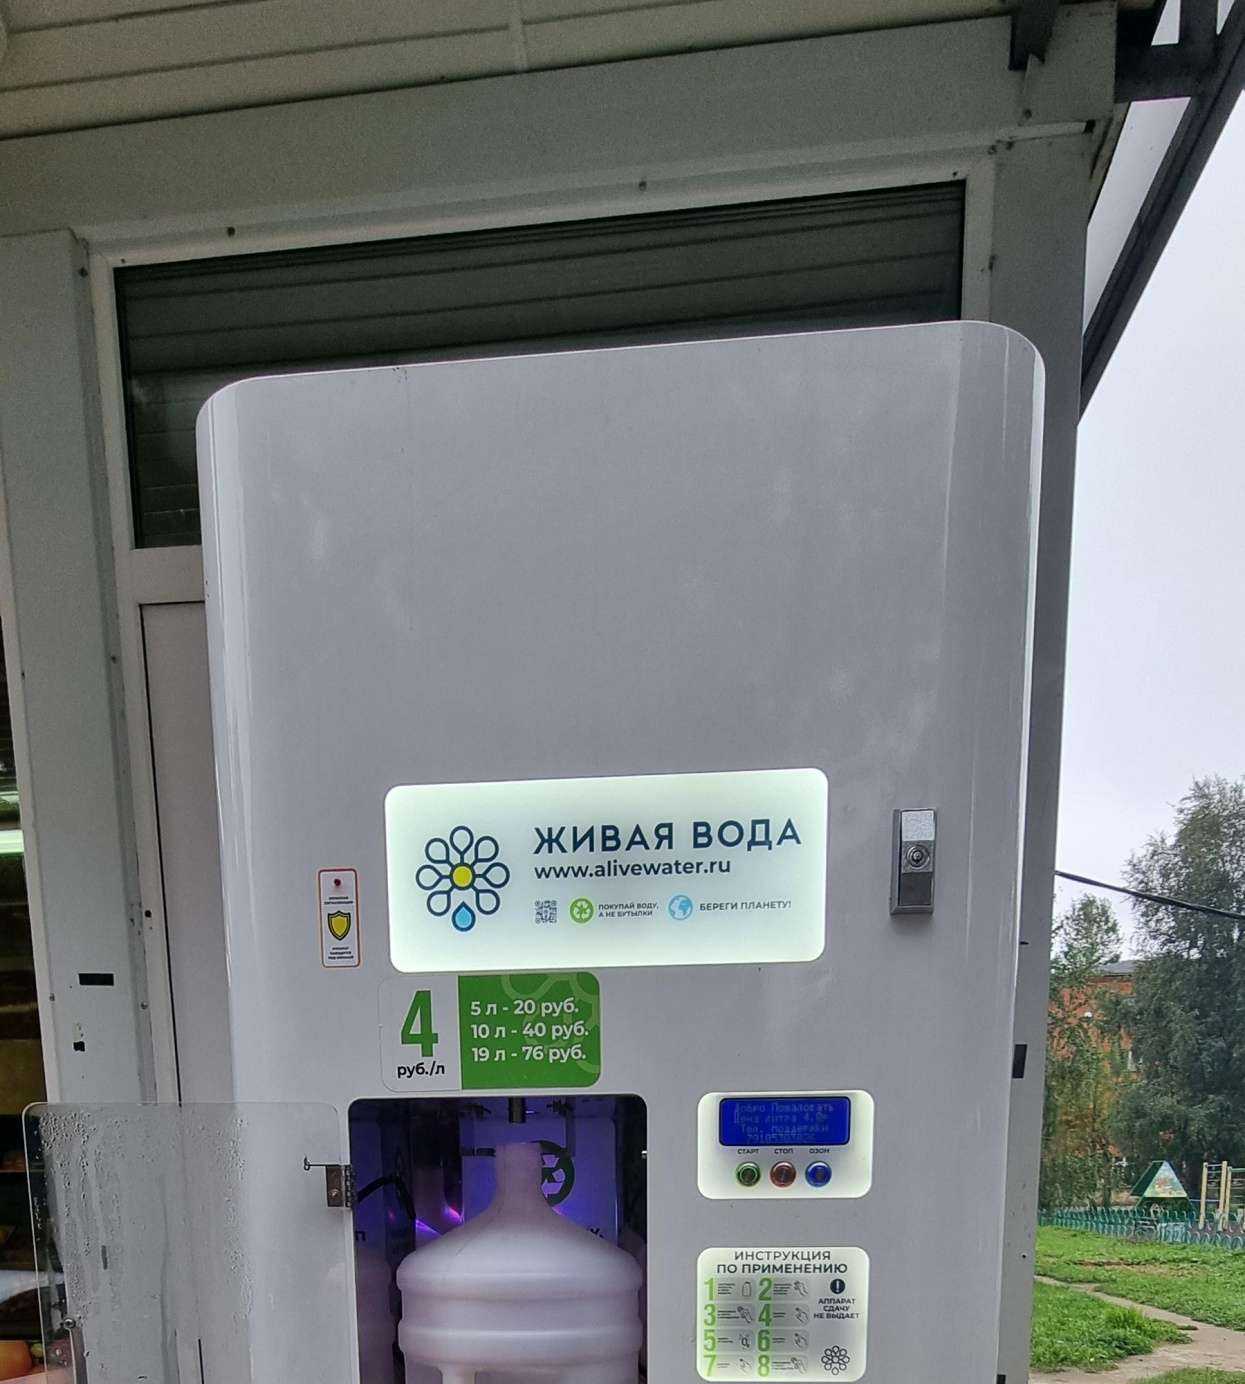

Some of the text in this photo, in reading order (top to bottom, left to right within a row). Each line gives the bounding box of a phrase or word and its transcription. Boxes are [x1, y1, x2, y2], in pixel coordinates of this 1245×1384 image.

[533, 818, 802, 854] ЖИВАЯ ВОДА
[534, 859, 731, 879] www.alivewater.ru
[599, 902, 635, 911] ПОКУПАЙ
[617, 910, 653, 918] БУТЫЛКИ
[700, 901, 791, 911] БЕРЕГИ ПЛАНЕТУ!
[470, 1001, 481, 1016] 5
[485, 1003, 497, 1015] л
[514, 1000, 535, 1015] 20
[541, 997, 579, 1017] руб.
[401, 989, 439, 1058] 4
[471, 1024, 489, 1038] 10
[494, 1026, 506, 1038] л
[522, 1023, 546, 1037] 40
[552, 1021, 589, 1039] руб.
[472, 1047, 489, 1062] 19
[494, 1048, 506, 1061] л
[522, 1046, 544, 1060] 76
[549, 1044, 586, 1063] руб.
[397, 1061, 445, 1079] руб./л
[734, 1251, 831, 1261] ИНСТРУКЦИЯ
[717, 1264, 848, 1274] ПО ПРИМЕНЕНИЮ
[704, 1278, 714, 1301] 1
[758, 1278, 772, 1301] 2
[704, 1304, 716, 1326] 3
[758, 1304, 773, 1327] 4
[704, 1330, 717, 1352] 5
[758, 1330, 770, 1352] 6
[704, 1355, 717, 1377] 7
[758, 1355, 770, 1377] 8
